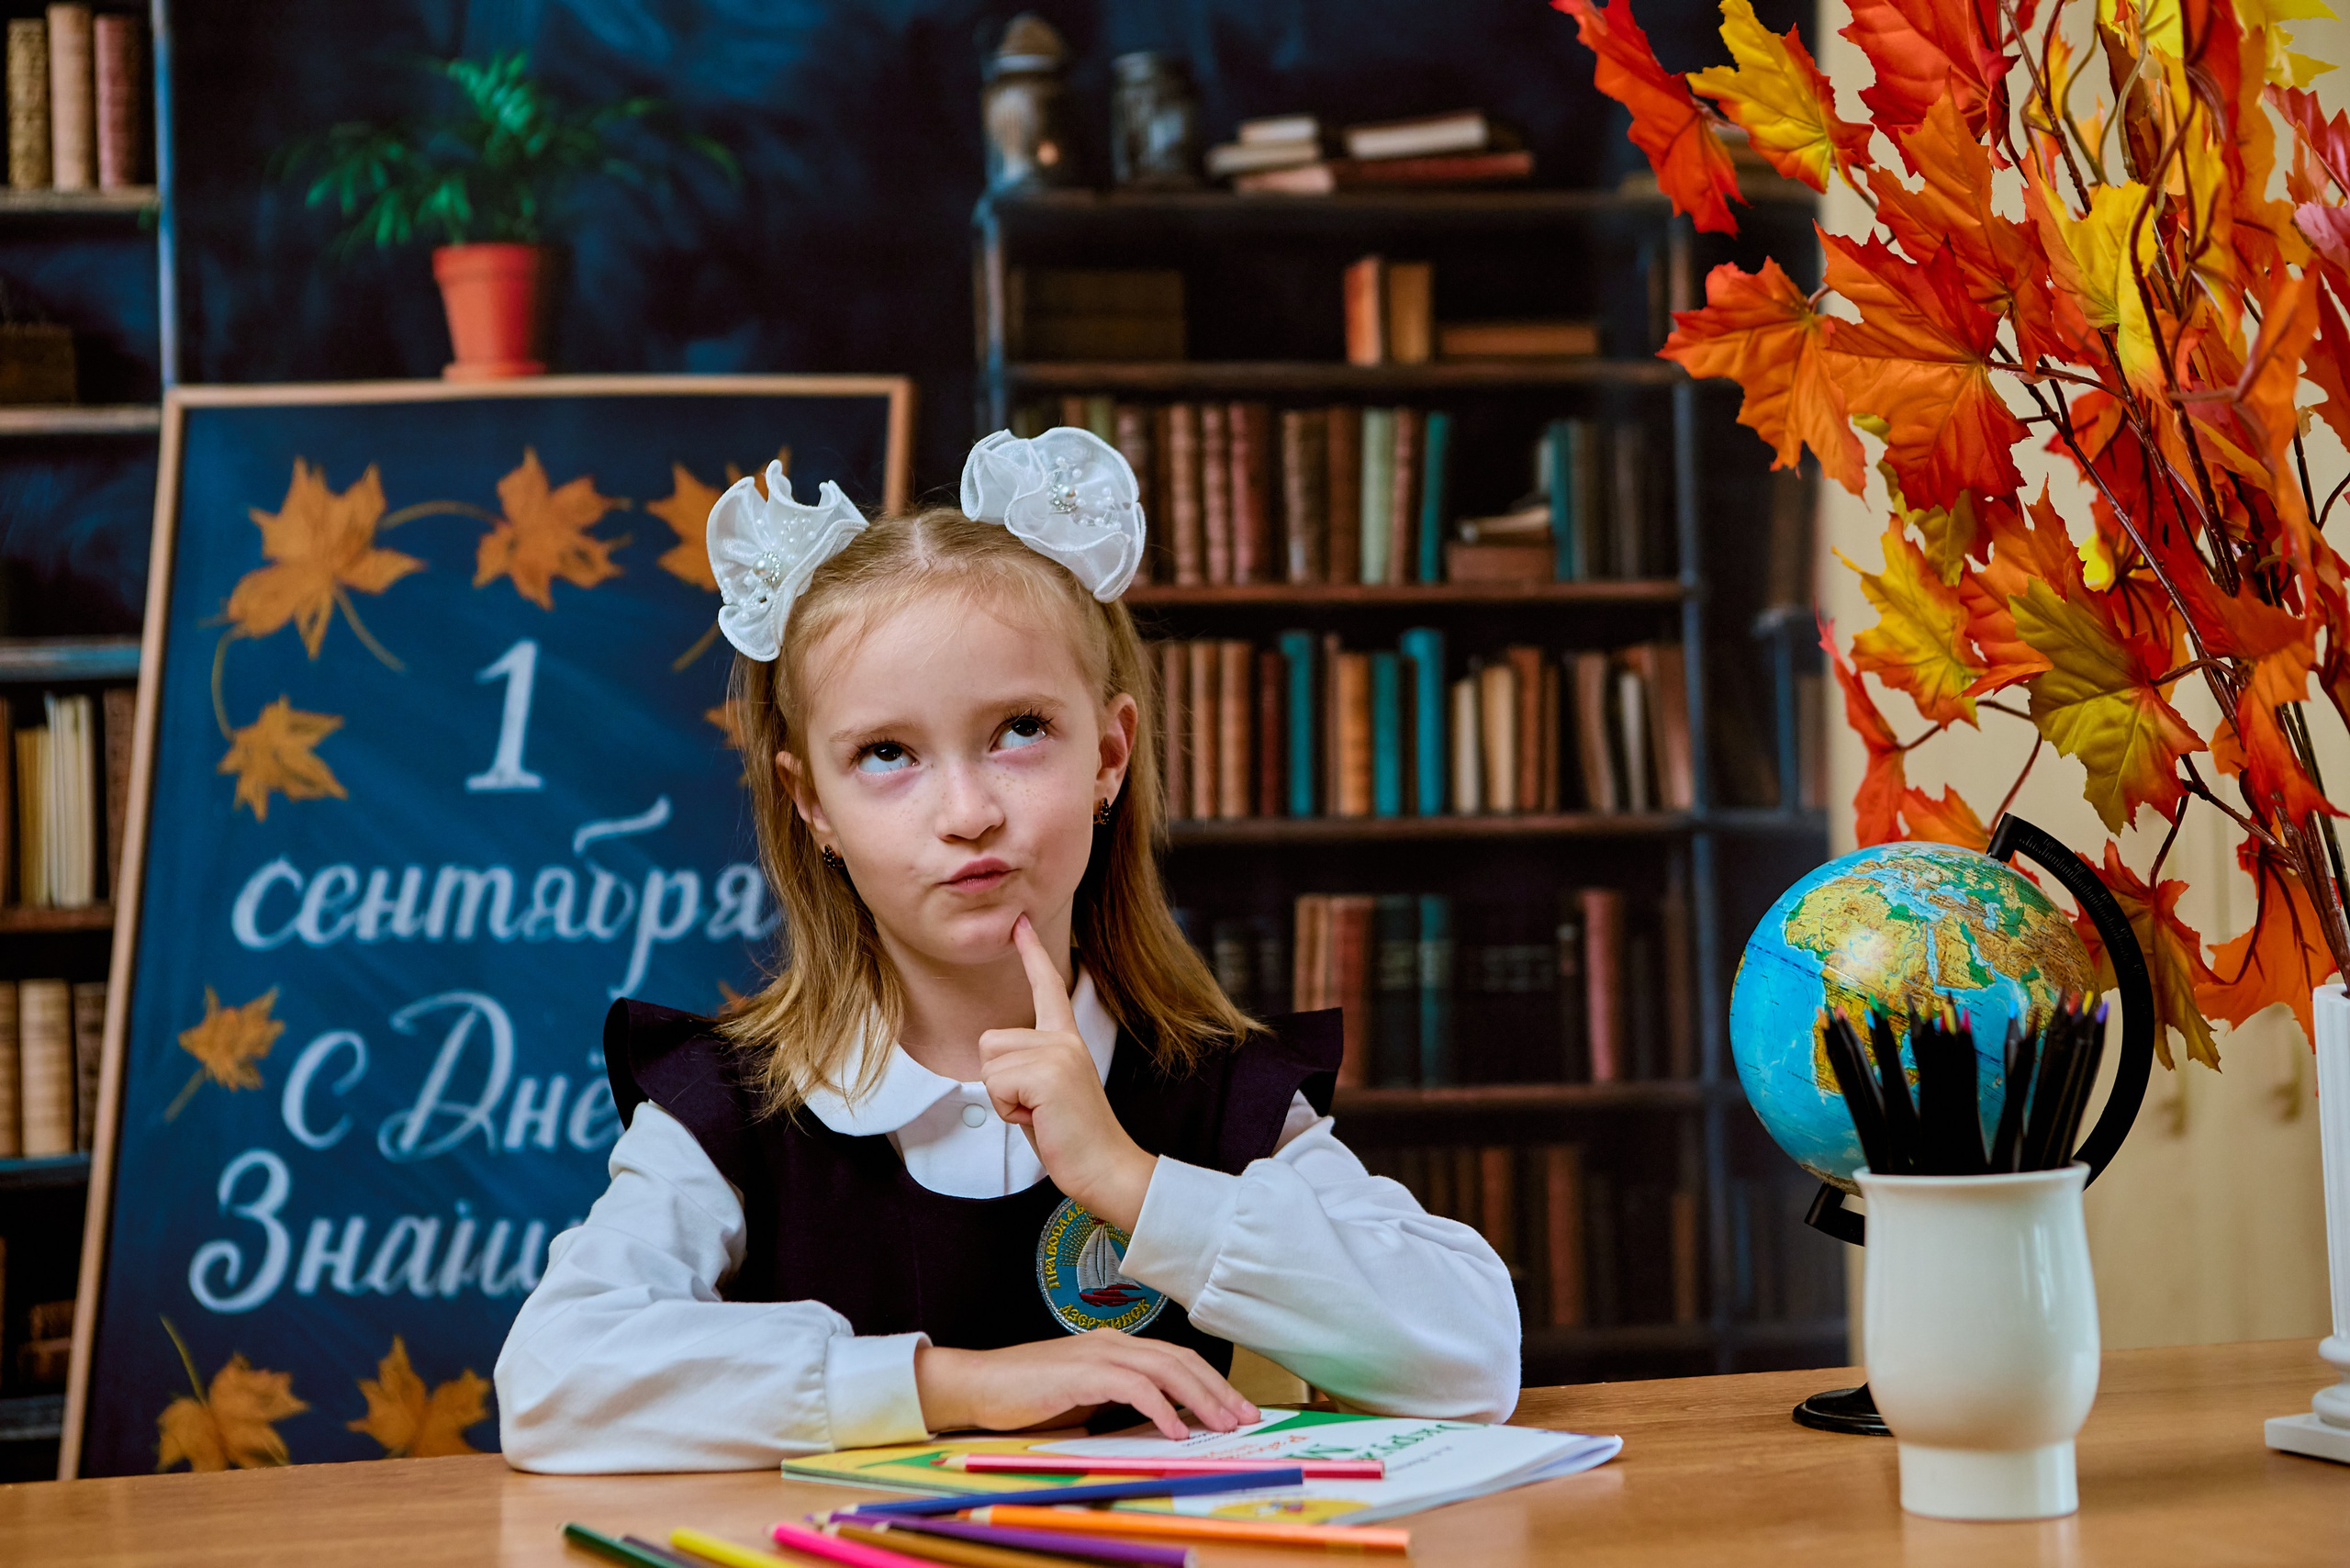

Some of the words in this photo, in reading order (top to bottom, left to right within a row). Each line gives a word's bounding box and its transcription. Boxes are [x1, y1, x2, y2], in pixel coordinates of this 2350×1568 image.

[465, 639, 543, 790] 1
[231, 795, 780, 1000] сентября
[377, 990, 628, 1163] Днё
[1045, 1203, 1085, 1289] ПРАВОСЛАВ
